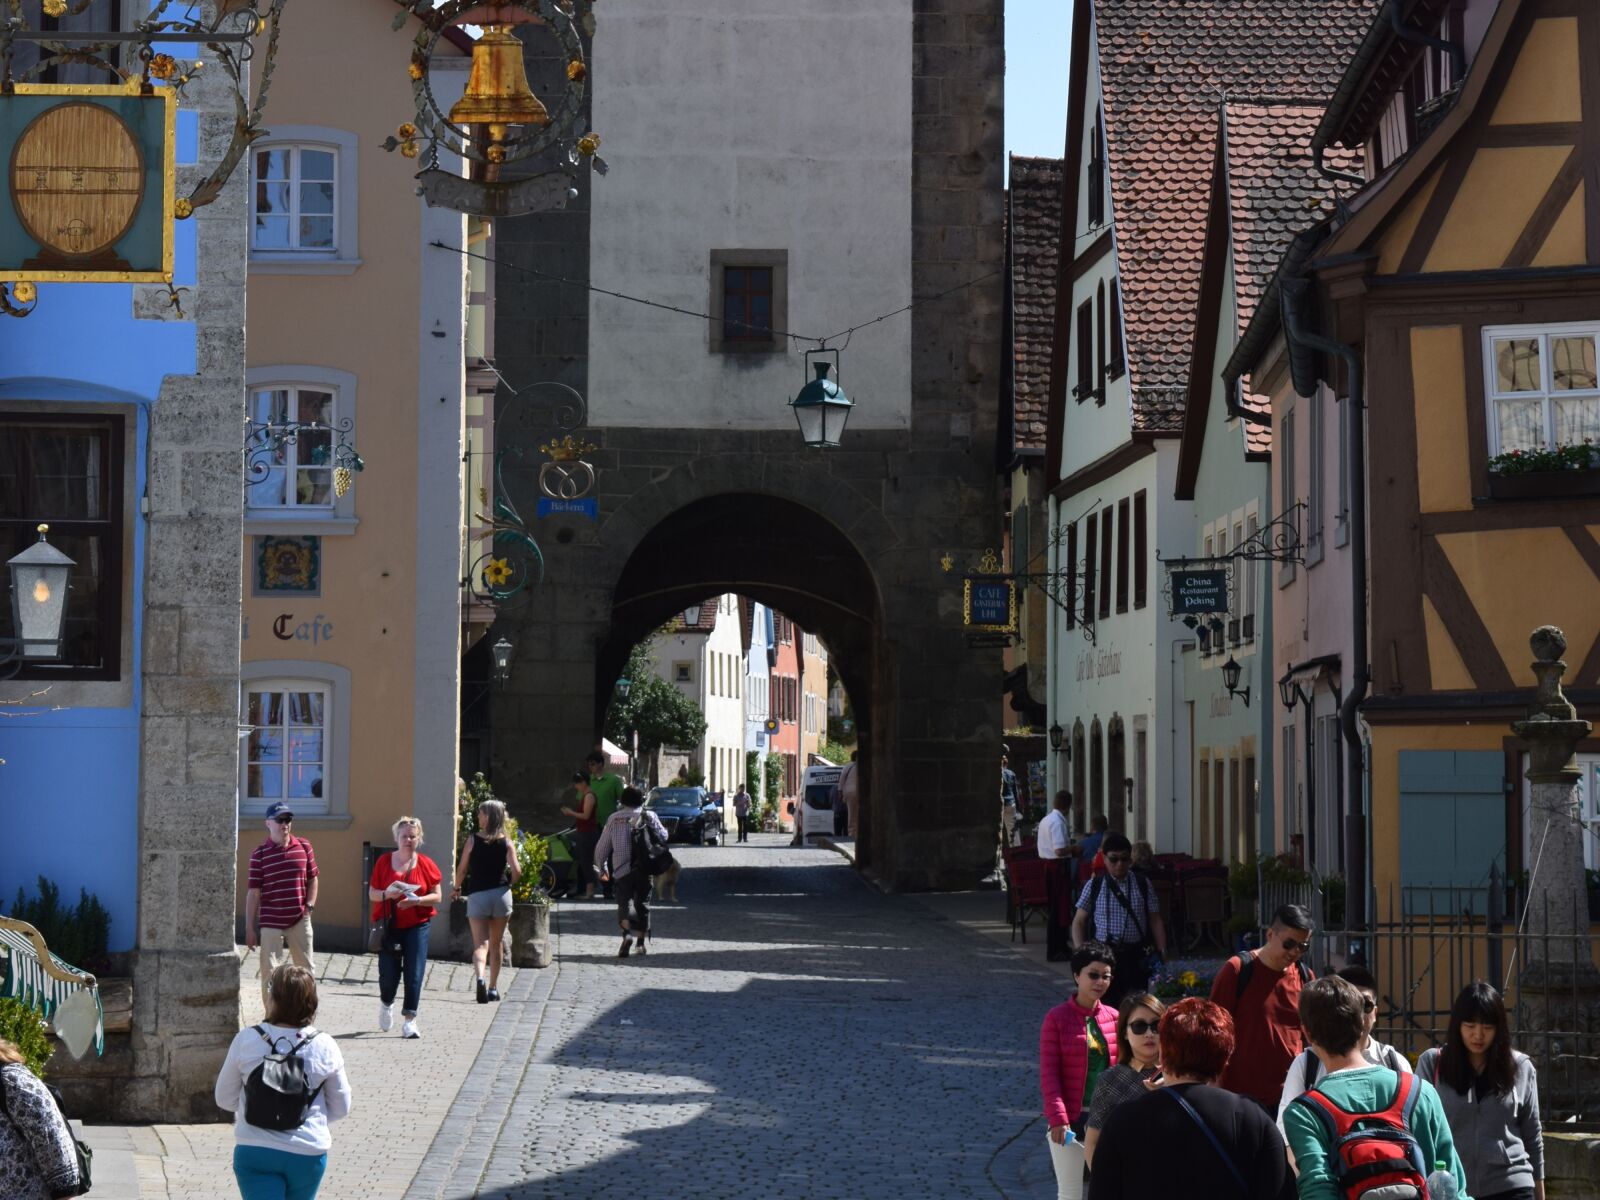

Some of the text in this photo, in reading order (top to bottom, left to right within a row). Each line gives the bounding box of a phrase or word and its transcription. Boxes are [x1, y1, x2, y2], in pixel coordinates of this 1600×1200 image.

[433, 177, 560, 210] GASTHOF
[1185, 577, 1212, 586] China
[1179, 587, 1219, 595] Restaurant
[1184, 596, 1216, 607] Peking
[272, 613, 334, 645] Cafe
